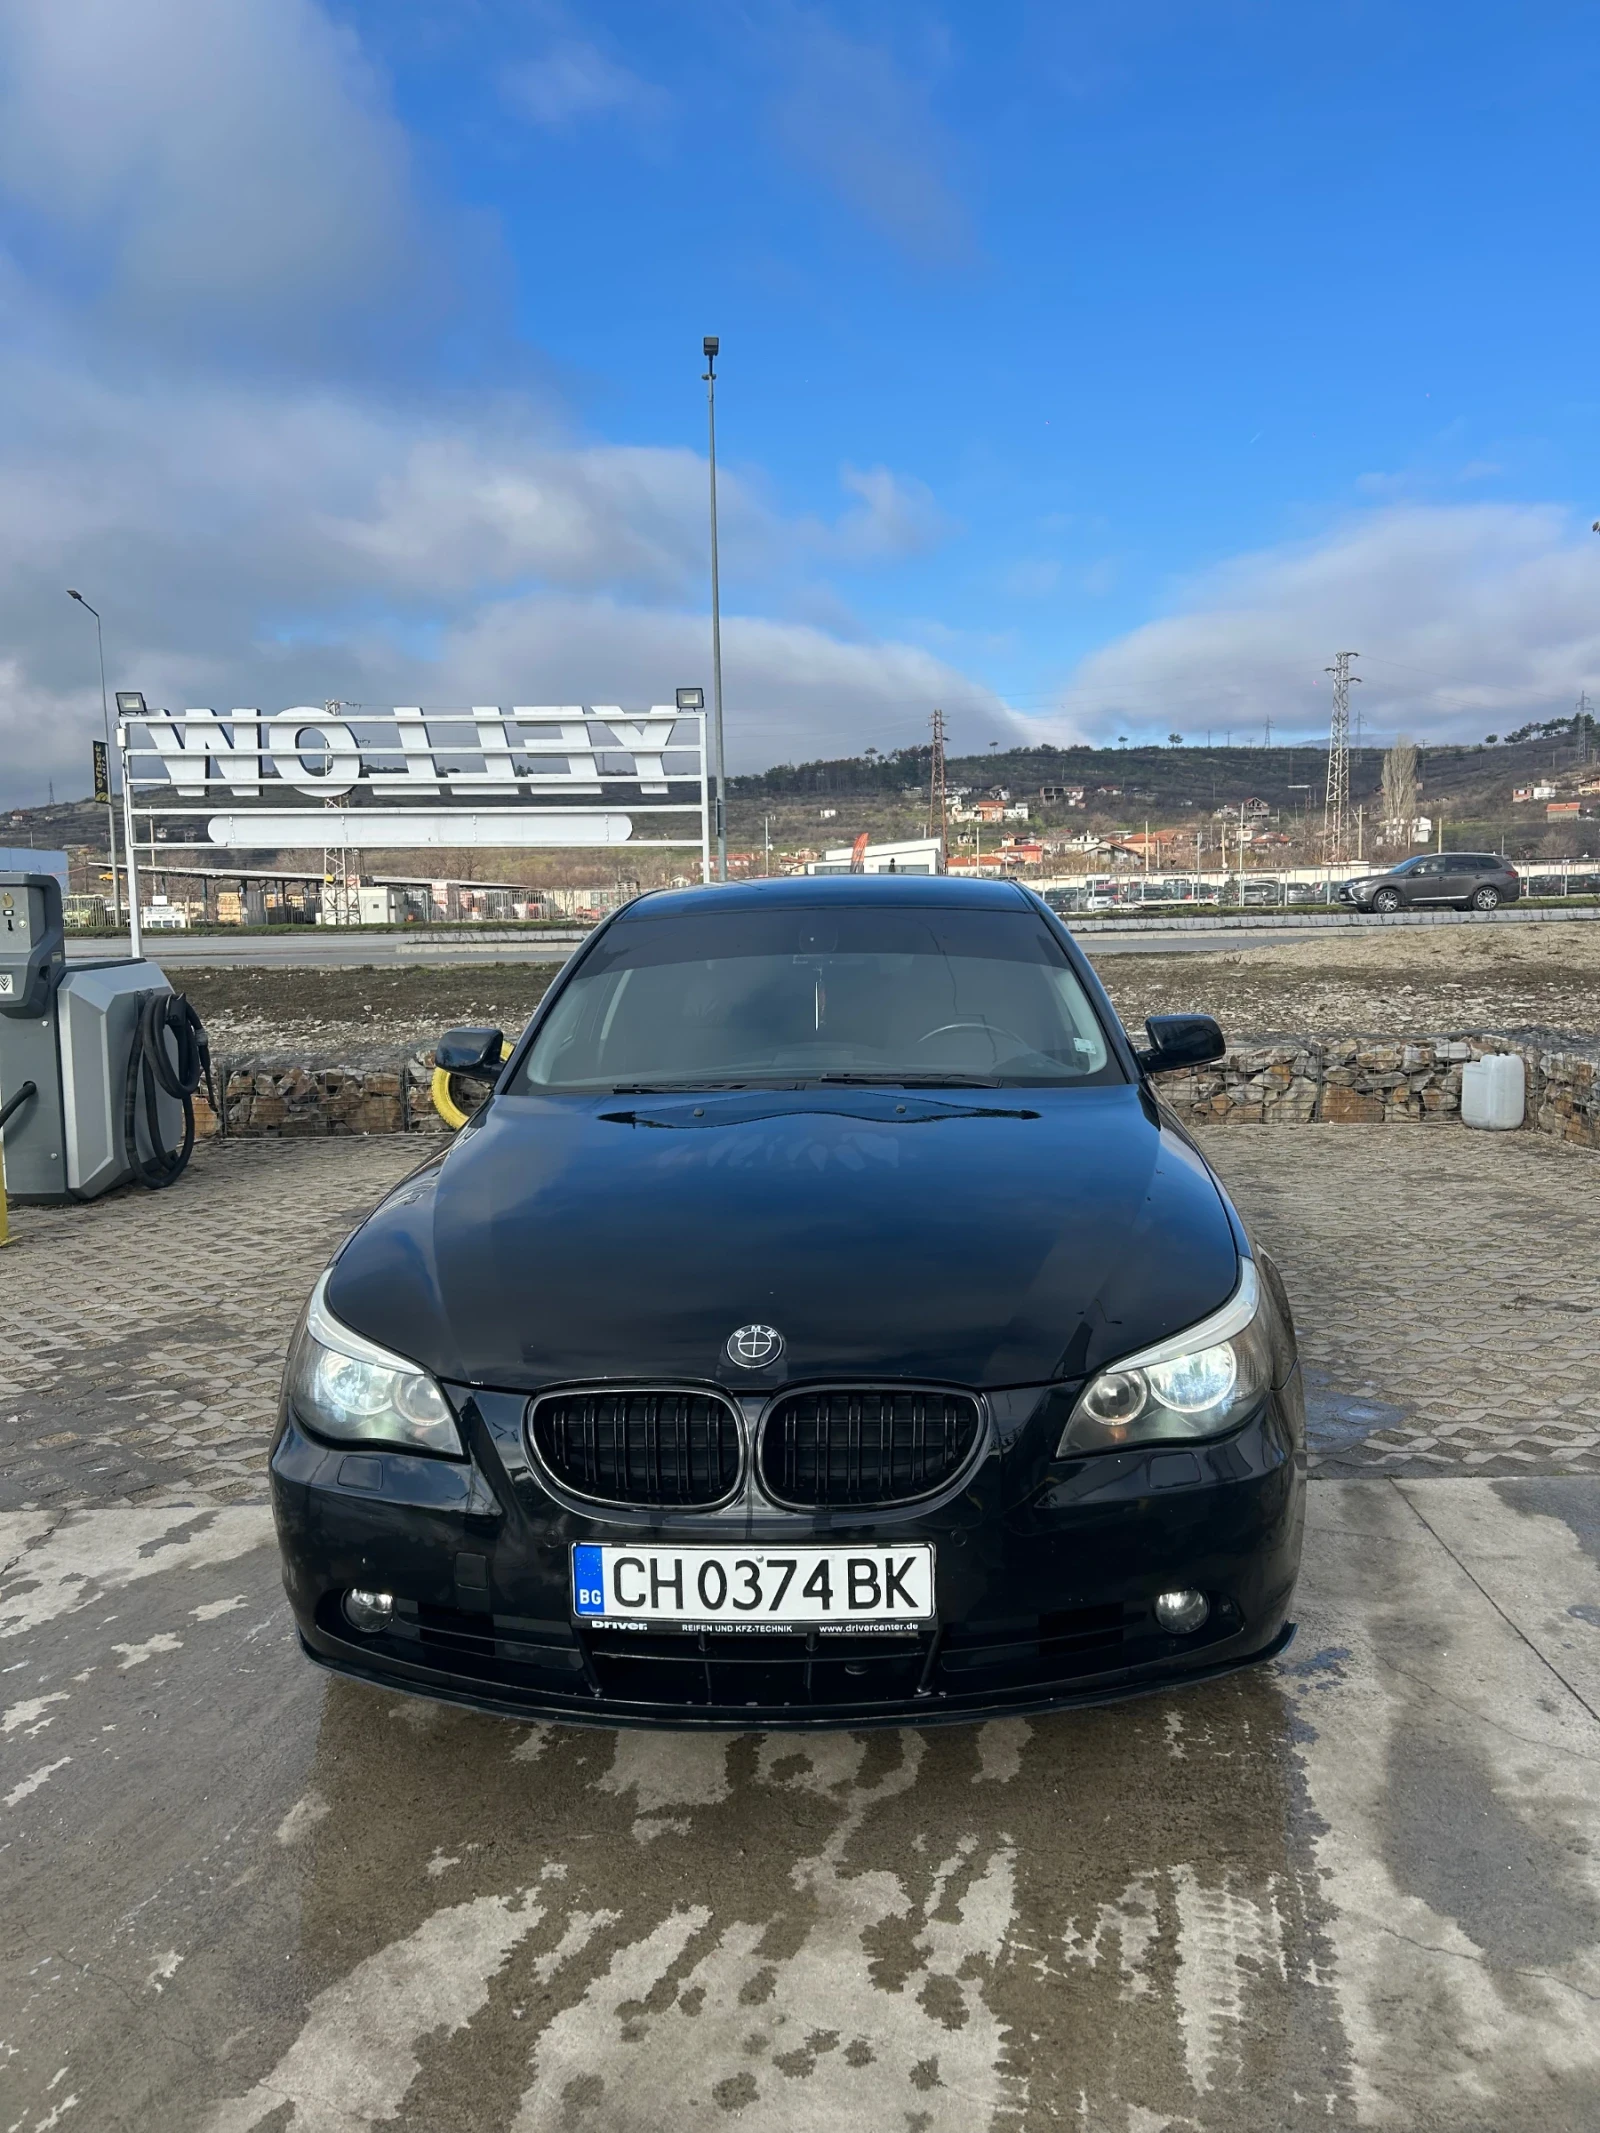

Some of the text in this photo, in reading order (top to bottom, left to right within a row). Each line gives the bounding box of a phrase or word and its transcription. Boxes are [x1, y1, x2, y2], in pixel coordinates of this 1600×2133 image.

[734, 1325, 777, 1338] BMW
[579, 1589, 601, 1605] BG
[682, 1624, 793, 1633] REIFEN UND KFZ-TECHNIK
[819, 1623, 919, 1633] www.drivercenter.de
